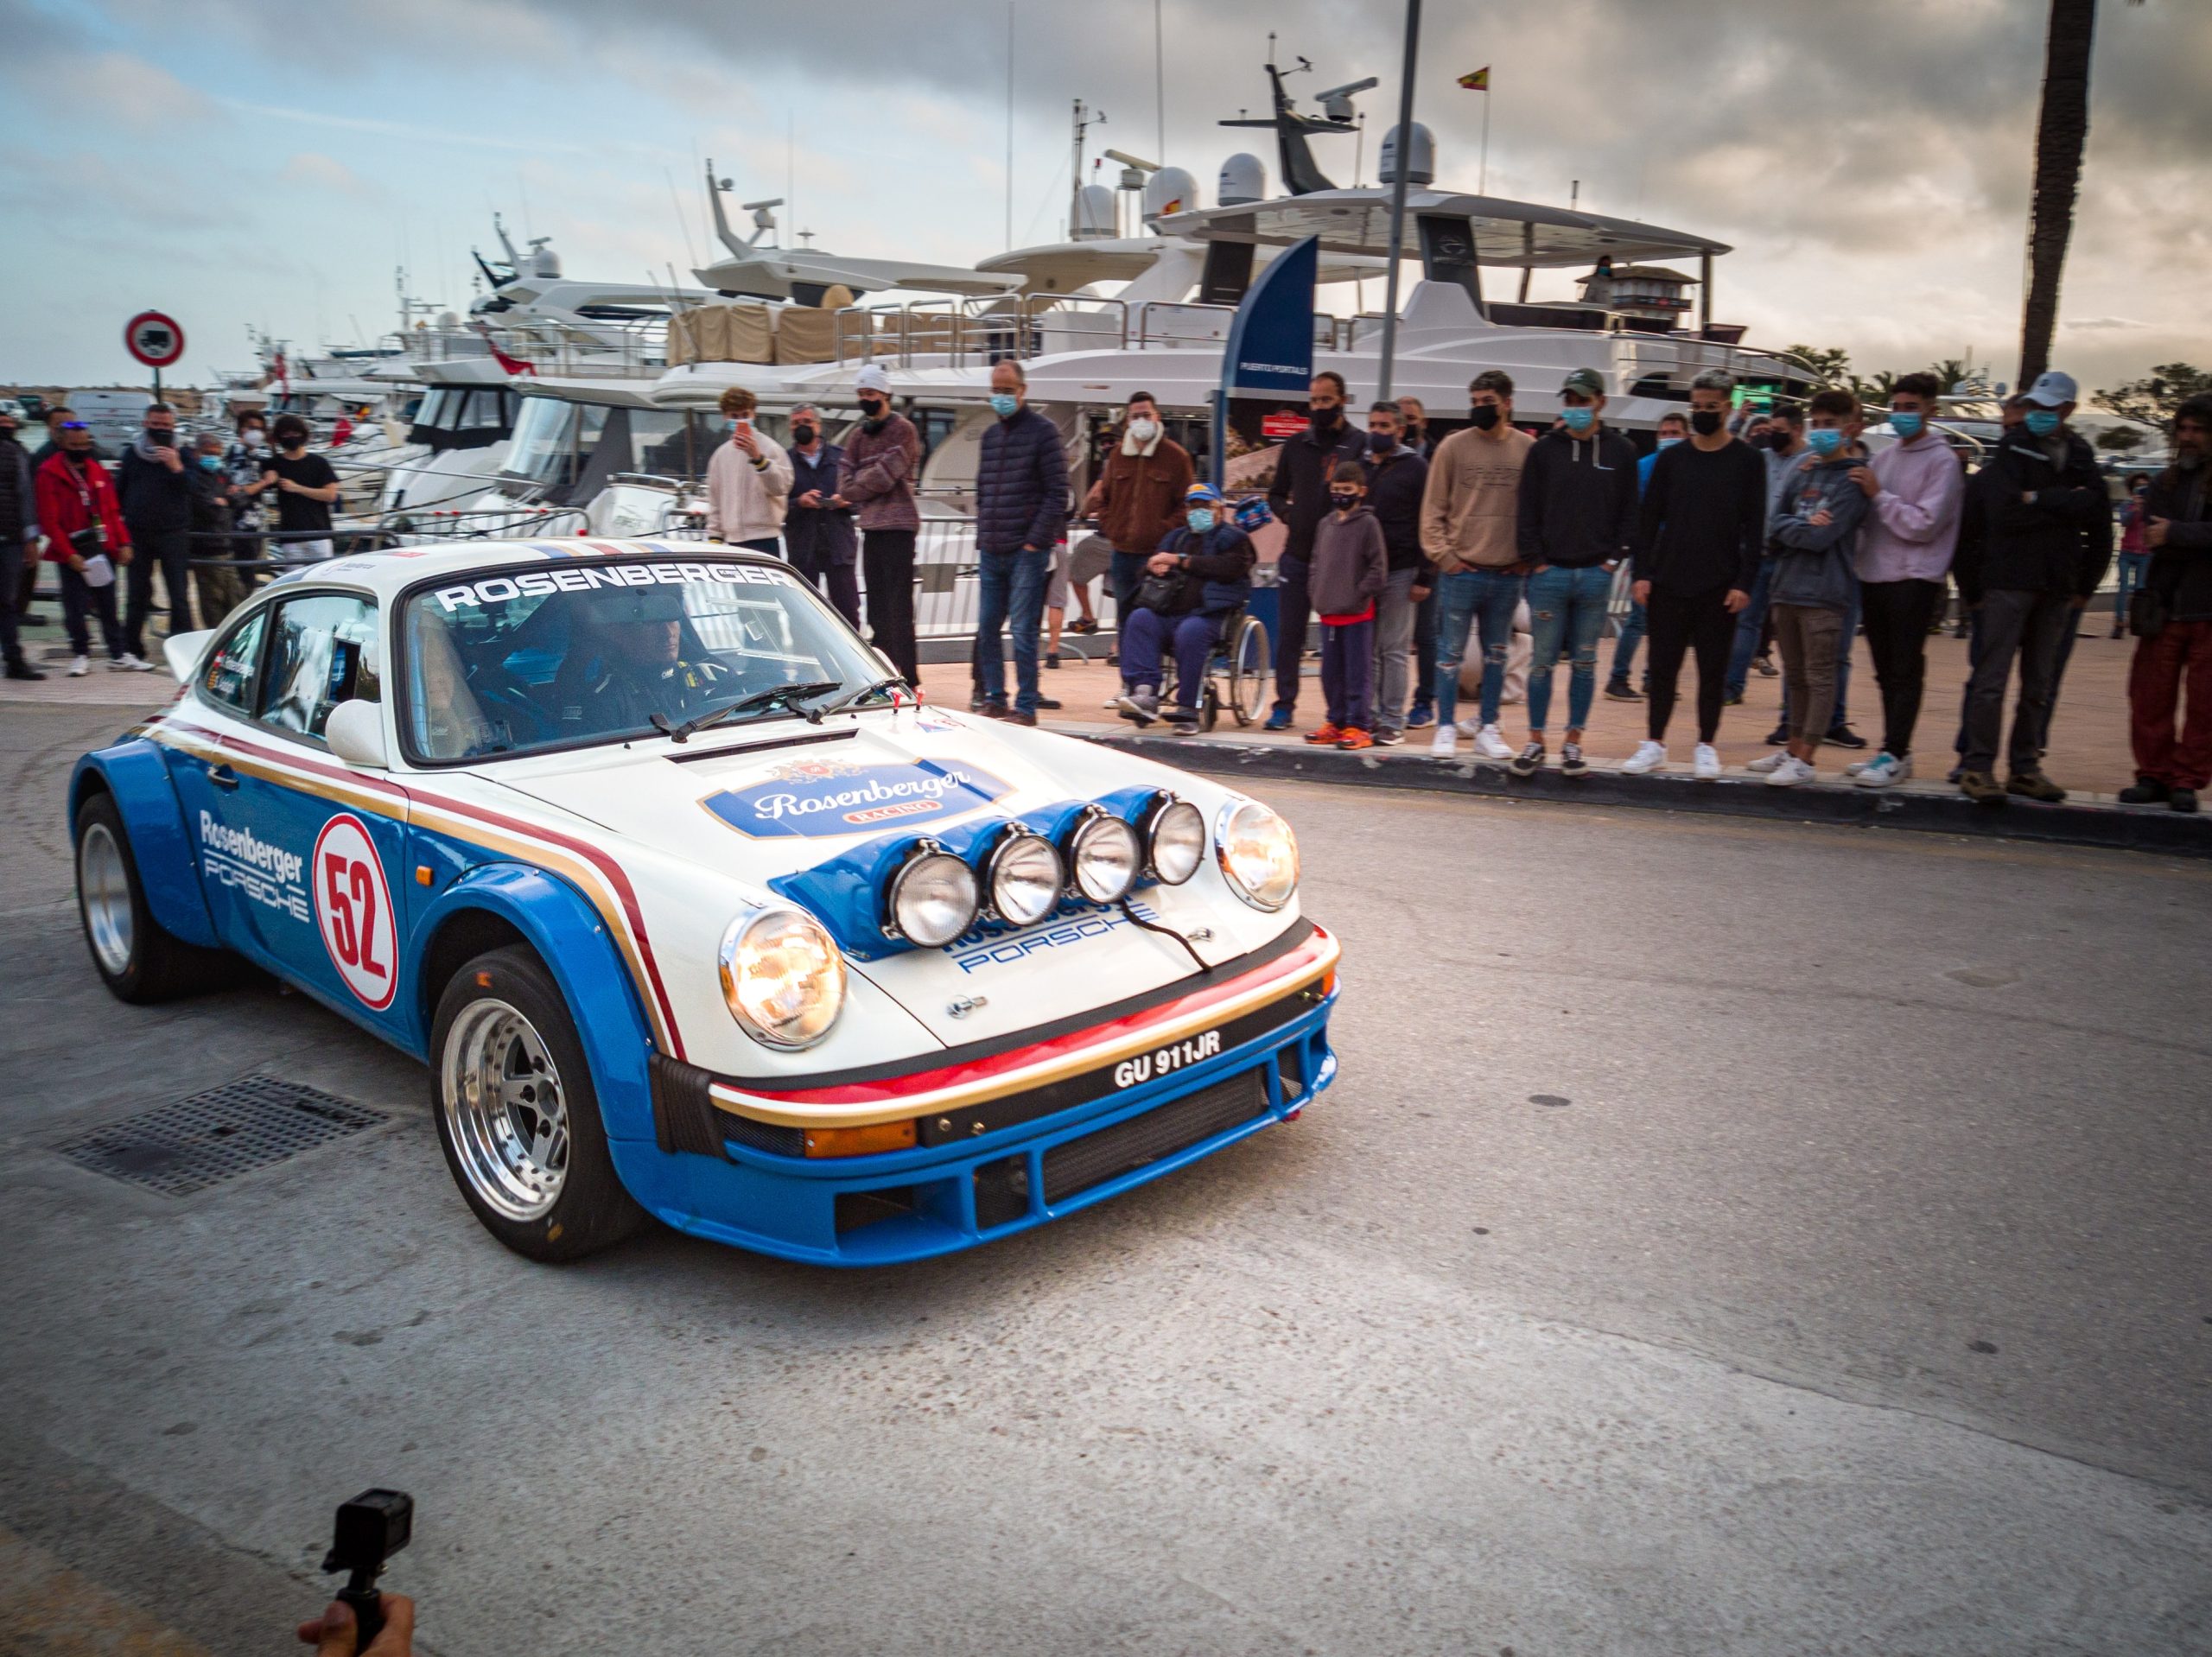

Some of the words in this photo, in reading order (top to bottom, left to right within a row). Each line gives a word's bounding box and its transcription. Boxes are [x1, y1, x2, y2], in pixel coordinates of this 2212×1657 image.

[435, 563, 797, 613] ROSENBERGER
[753, 770, 971, 819] Rosenberger
[855, 802, 933, 822] RACING
[200, 809, 302, 883] Rosenberger
[204, 858, 310, 924] PORSCHE
[325, 852, 387, 979] 52
[1115, 1055, 1151, 1088] GU
[1155, 1030, 1220, 1074] 911JR
